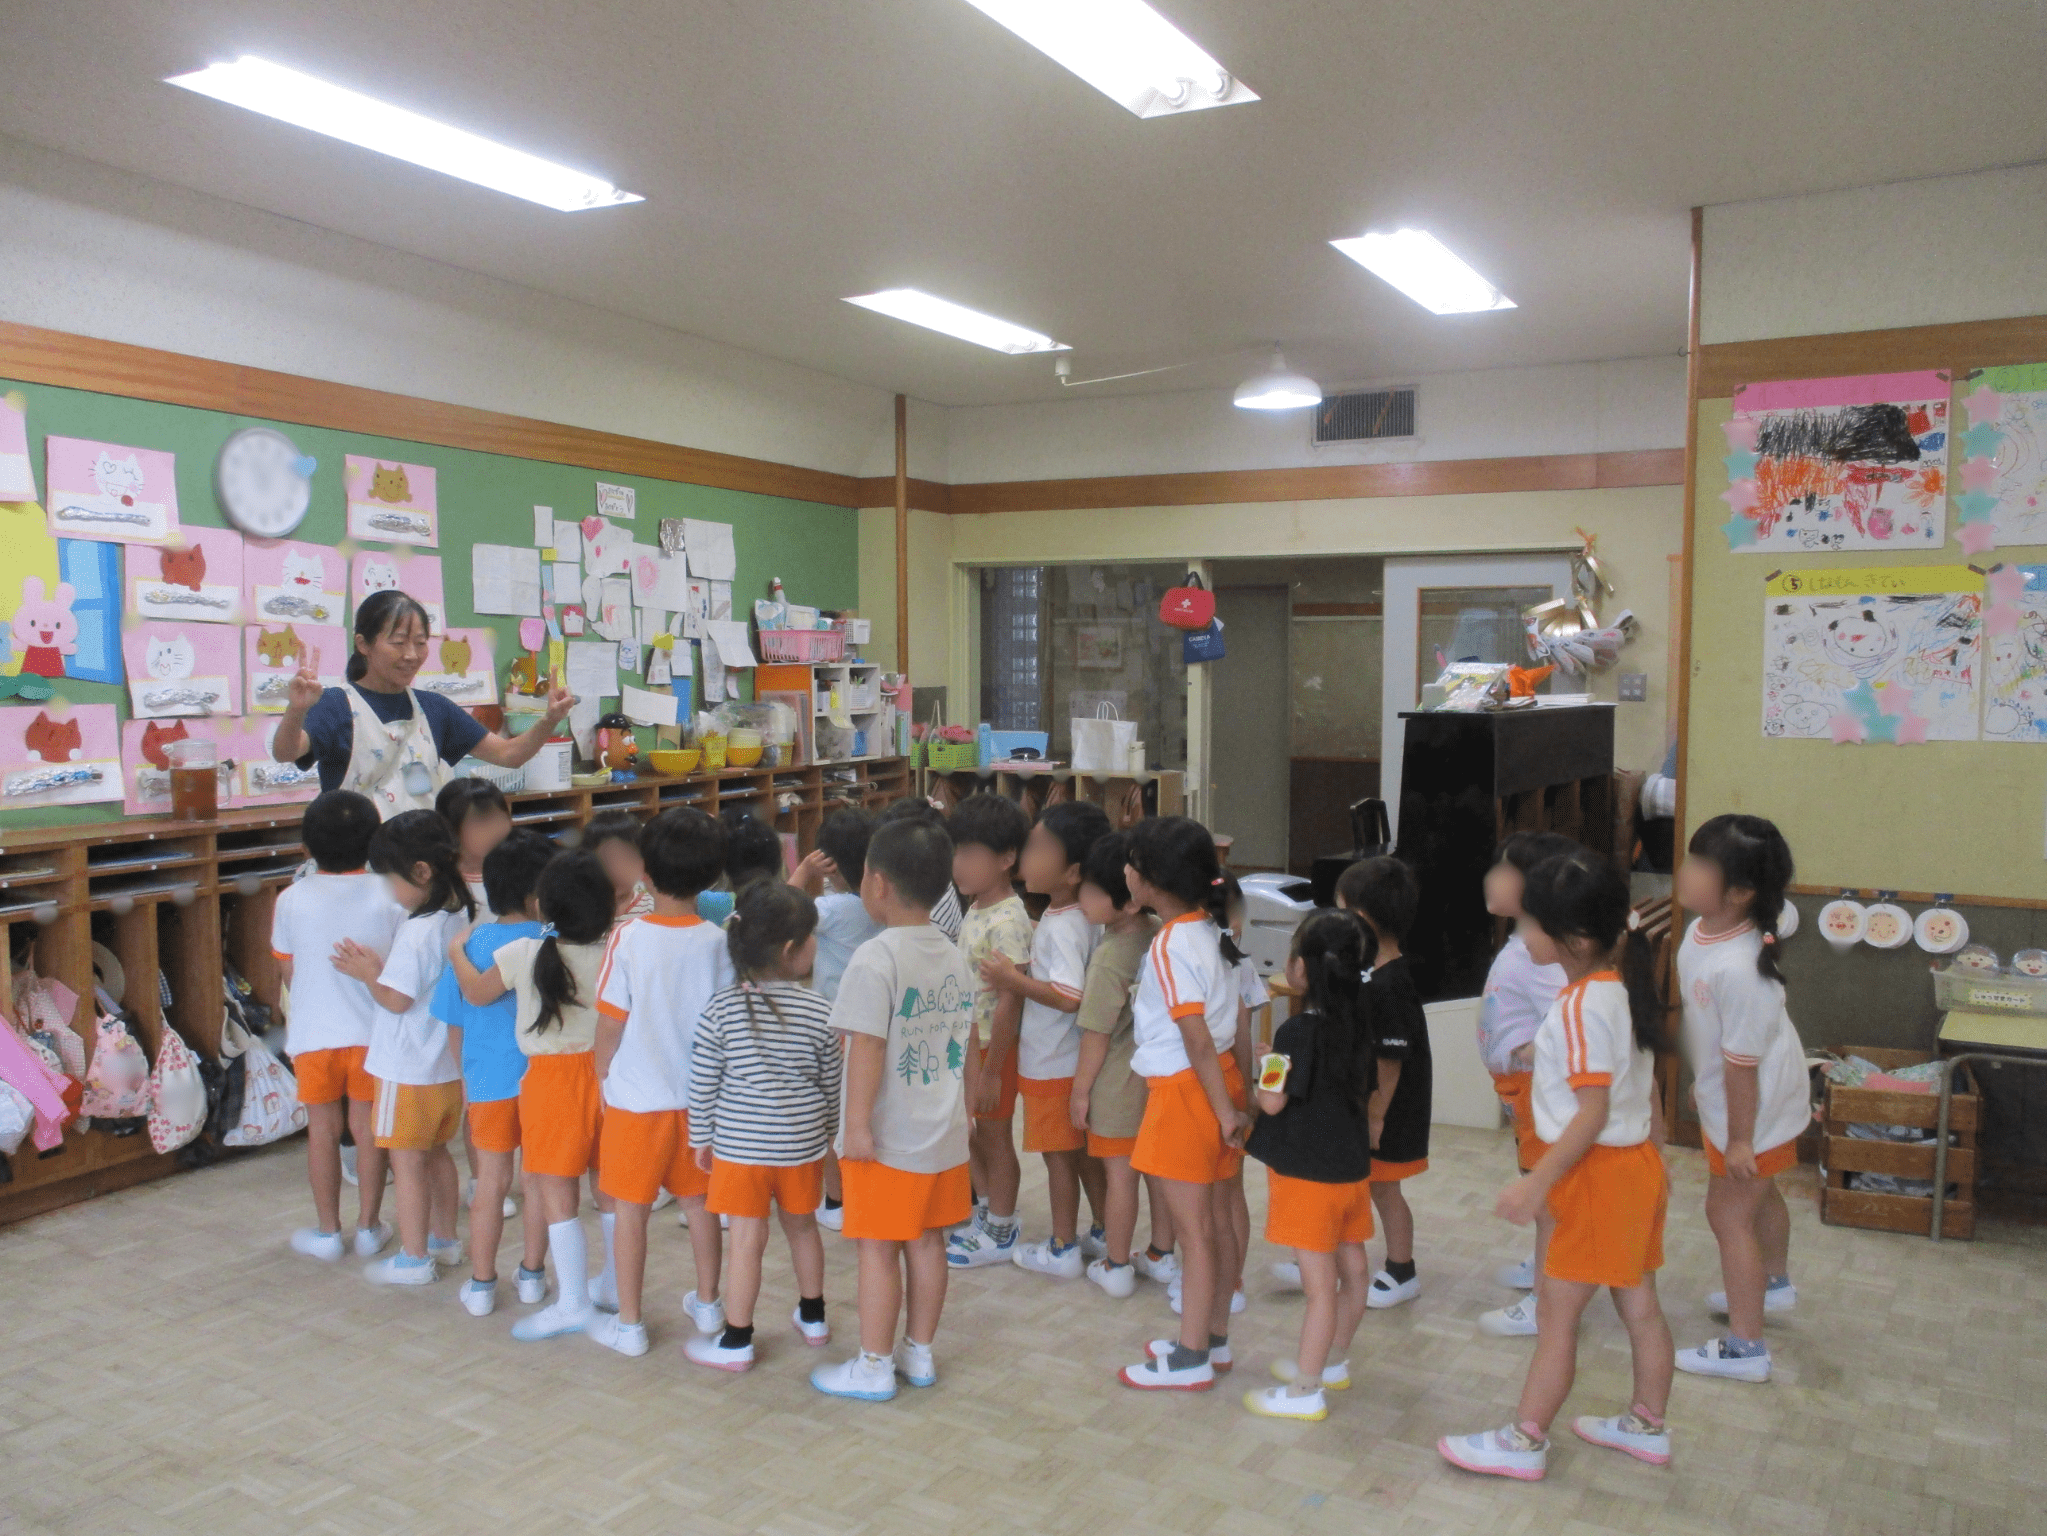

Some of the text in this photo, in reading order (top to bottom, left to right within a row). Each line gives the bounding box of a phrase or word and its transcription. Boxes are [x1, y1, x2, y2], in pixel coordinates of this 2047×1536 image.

[1974, 993, 2026, 1003] しゅっせきカード
[901, 1026, 923, 1038] RUN
[930, 1022, 949, 1034] FOR
